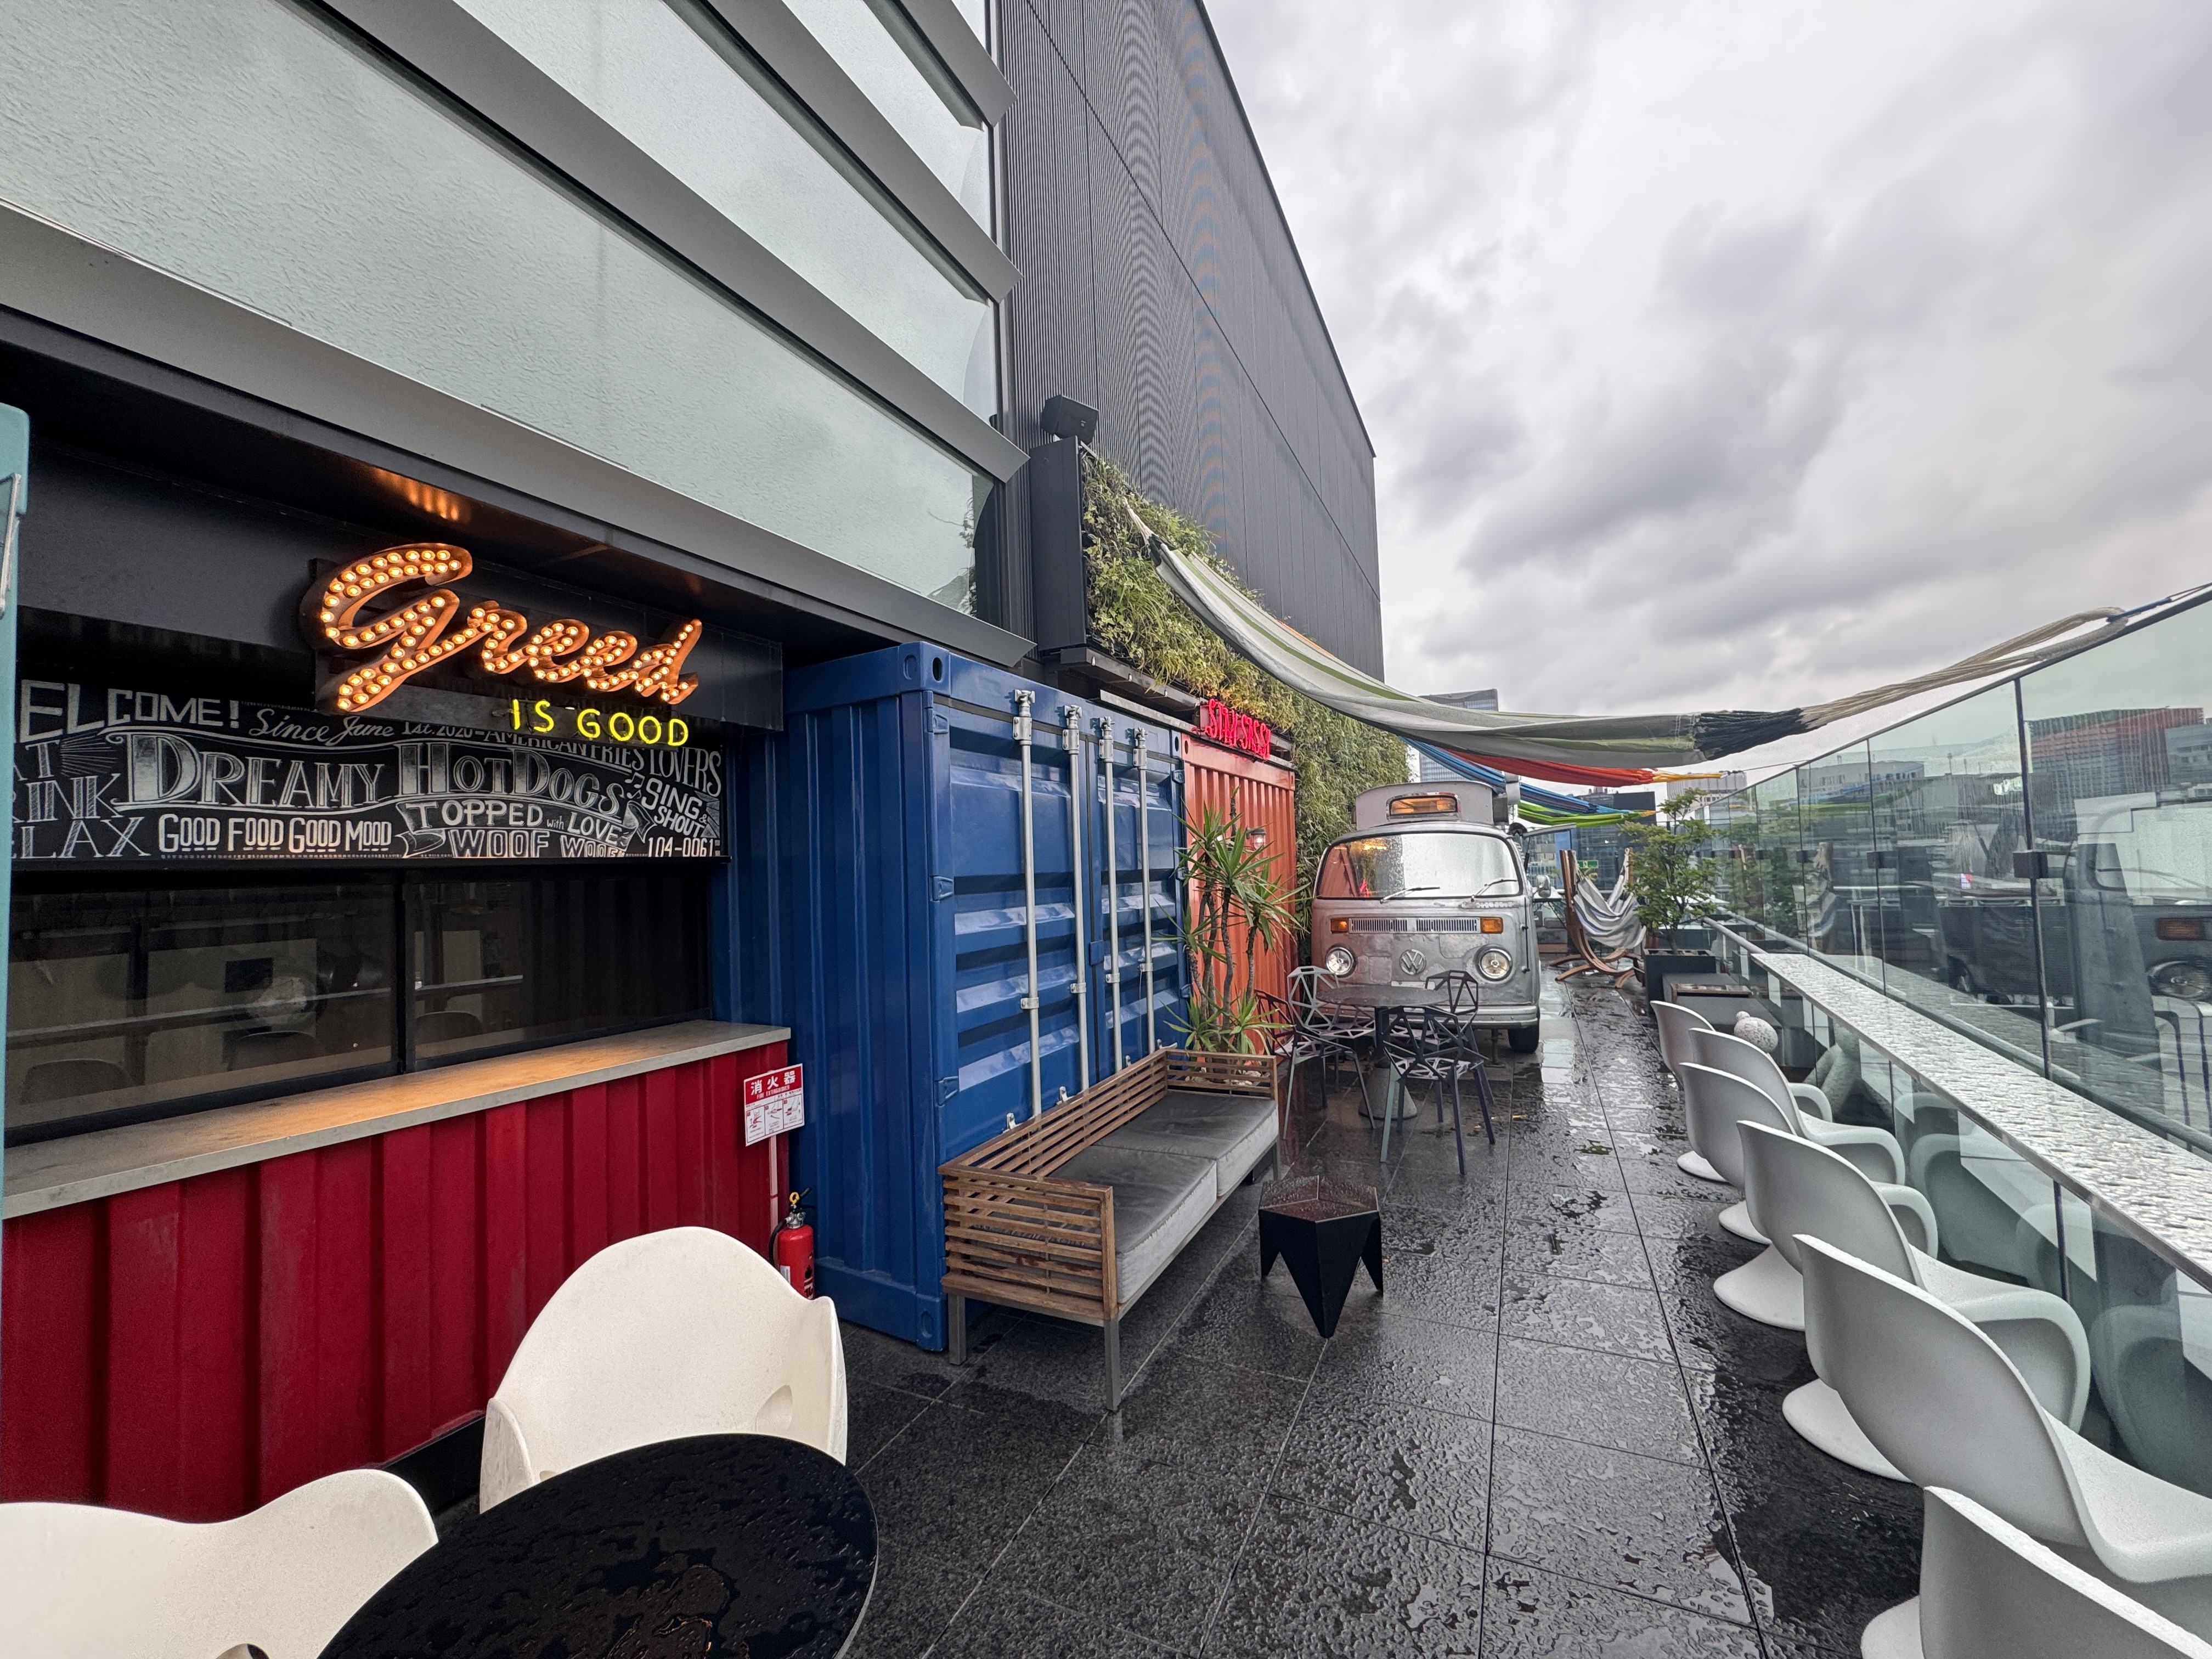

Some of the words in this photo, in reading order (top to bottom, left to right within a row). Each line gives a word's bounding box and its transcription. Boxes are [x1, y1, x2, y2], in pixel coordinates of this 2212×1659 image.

[321, 543, 702, 712] Greed
[20, 679, 239, 743] ELCOME!
[511, 698, 554, 733] IS
[576, 708, 689, 746] GOOD
[249, 708, 329, 741] Since
[324, 716, 394, 746] June
[650, 747, 722, 797] LOVERS
[13, 773, 124, 823] INK
[641, 777, 703, 820] SING
[11, 816, 151, 859] LAX
[405, 799, 543, 830] TOPPED
[567, 812, 623, 846] LOVE
[448, 829, 550, 858] WOOF
[653, 806, 706, 838] SHOUT
[647, 836, 714, 857] 104-0061
[750, 1070, 796, 1096] 消火器
